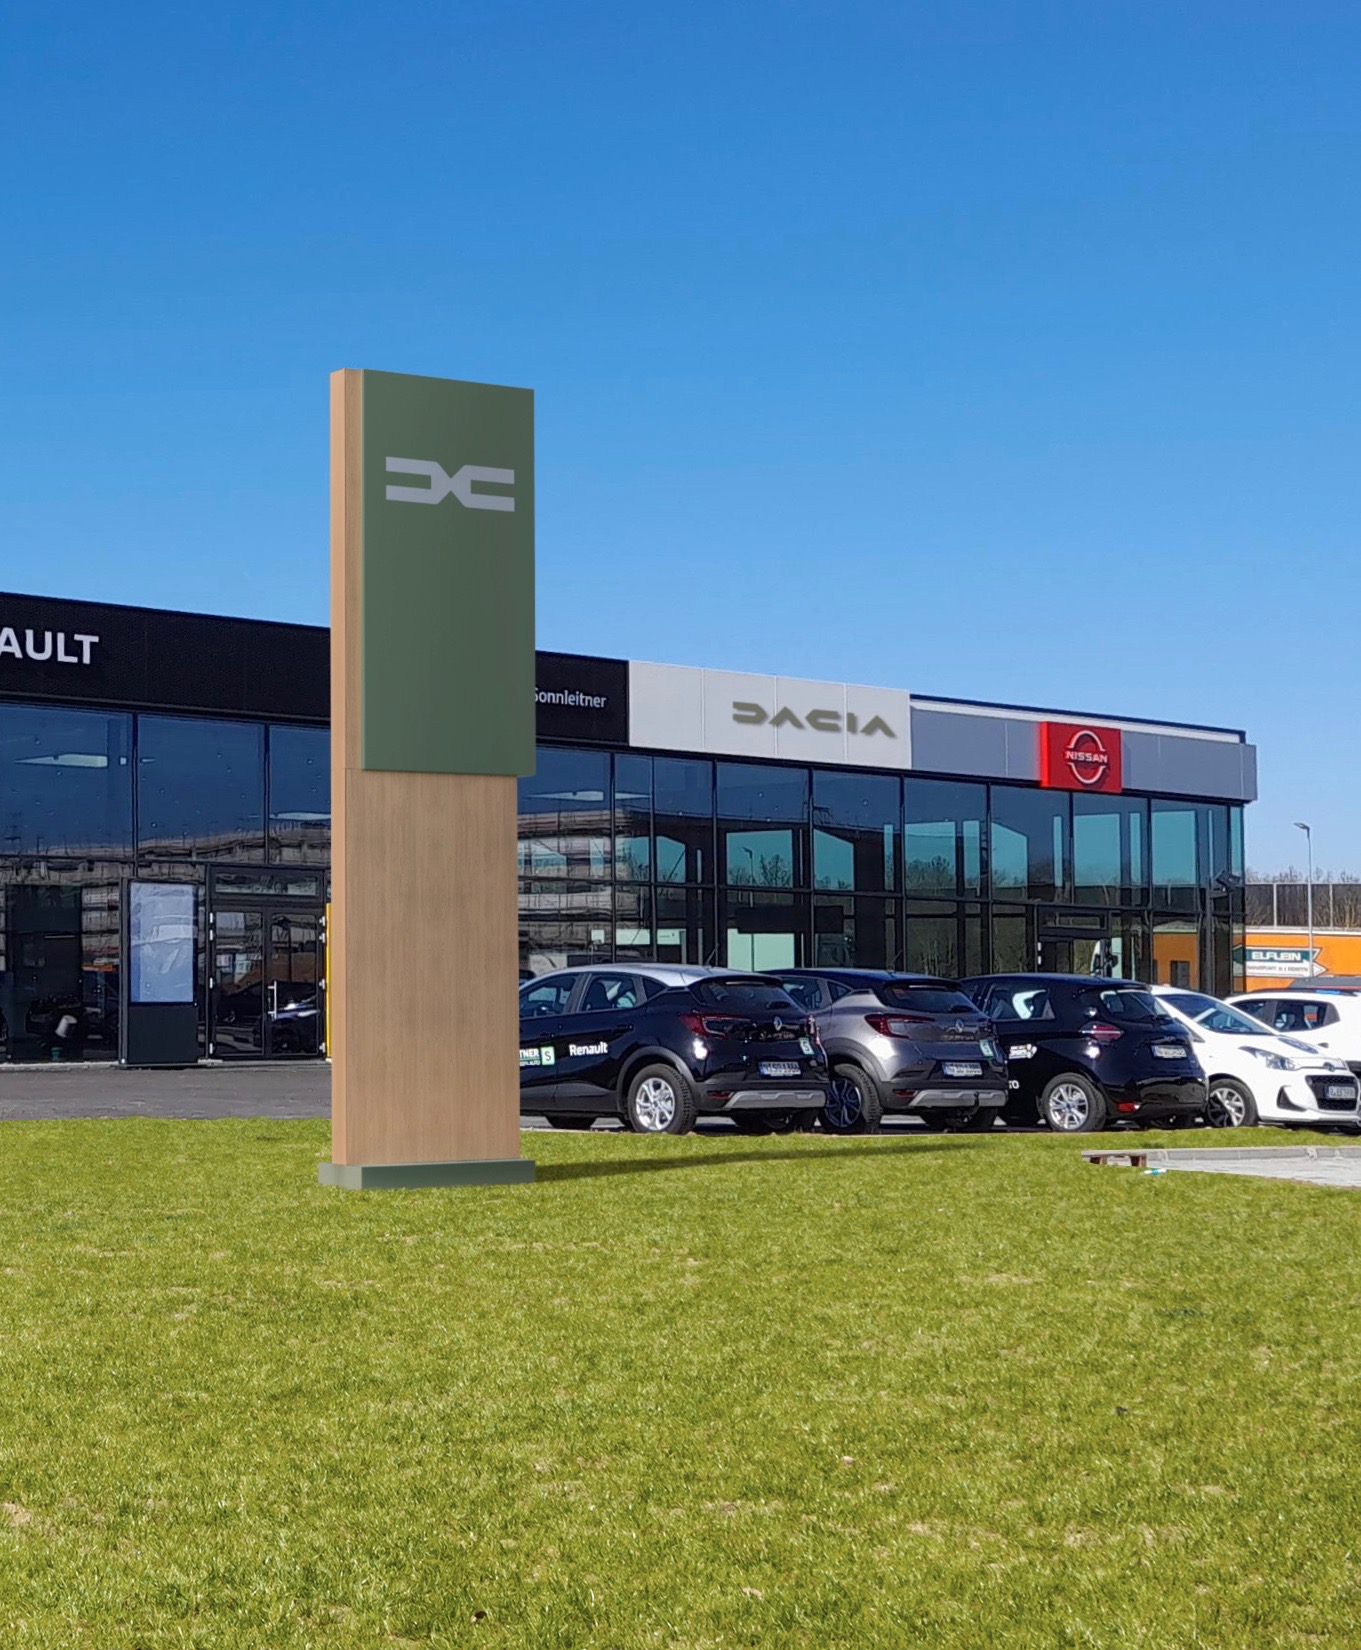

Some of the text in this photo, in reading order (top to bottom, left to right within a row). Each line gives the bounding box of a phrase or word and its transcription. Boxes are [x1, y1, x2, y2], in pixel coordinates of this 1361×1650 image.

[732, 701, 897, 738] DACIA
[1065, 751, 1108, 763] NISSAN
[569, 1041, 608, 1057] Renault
